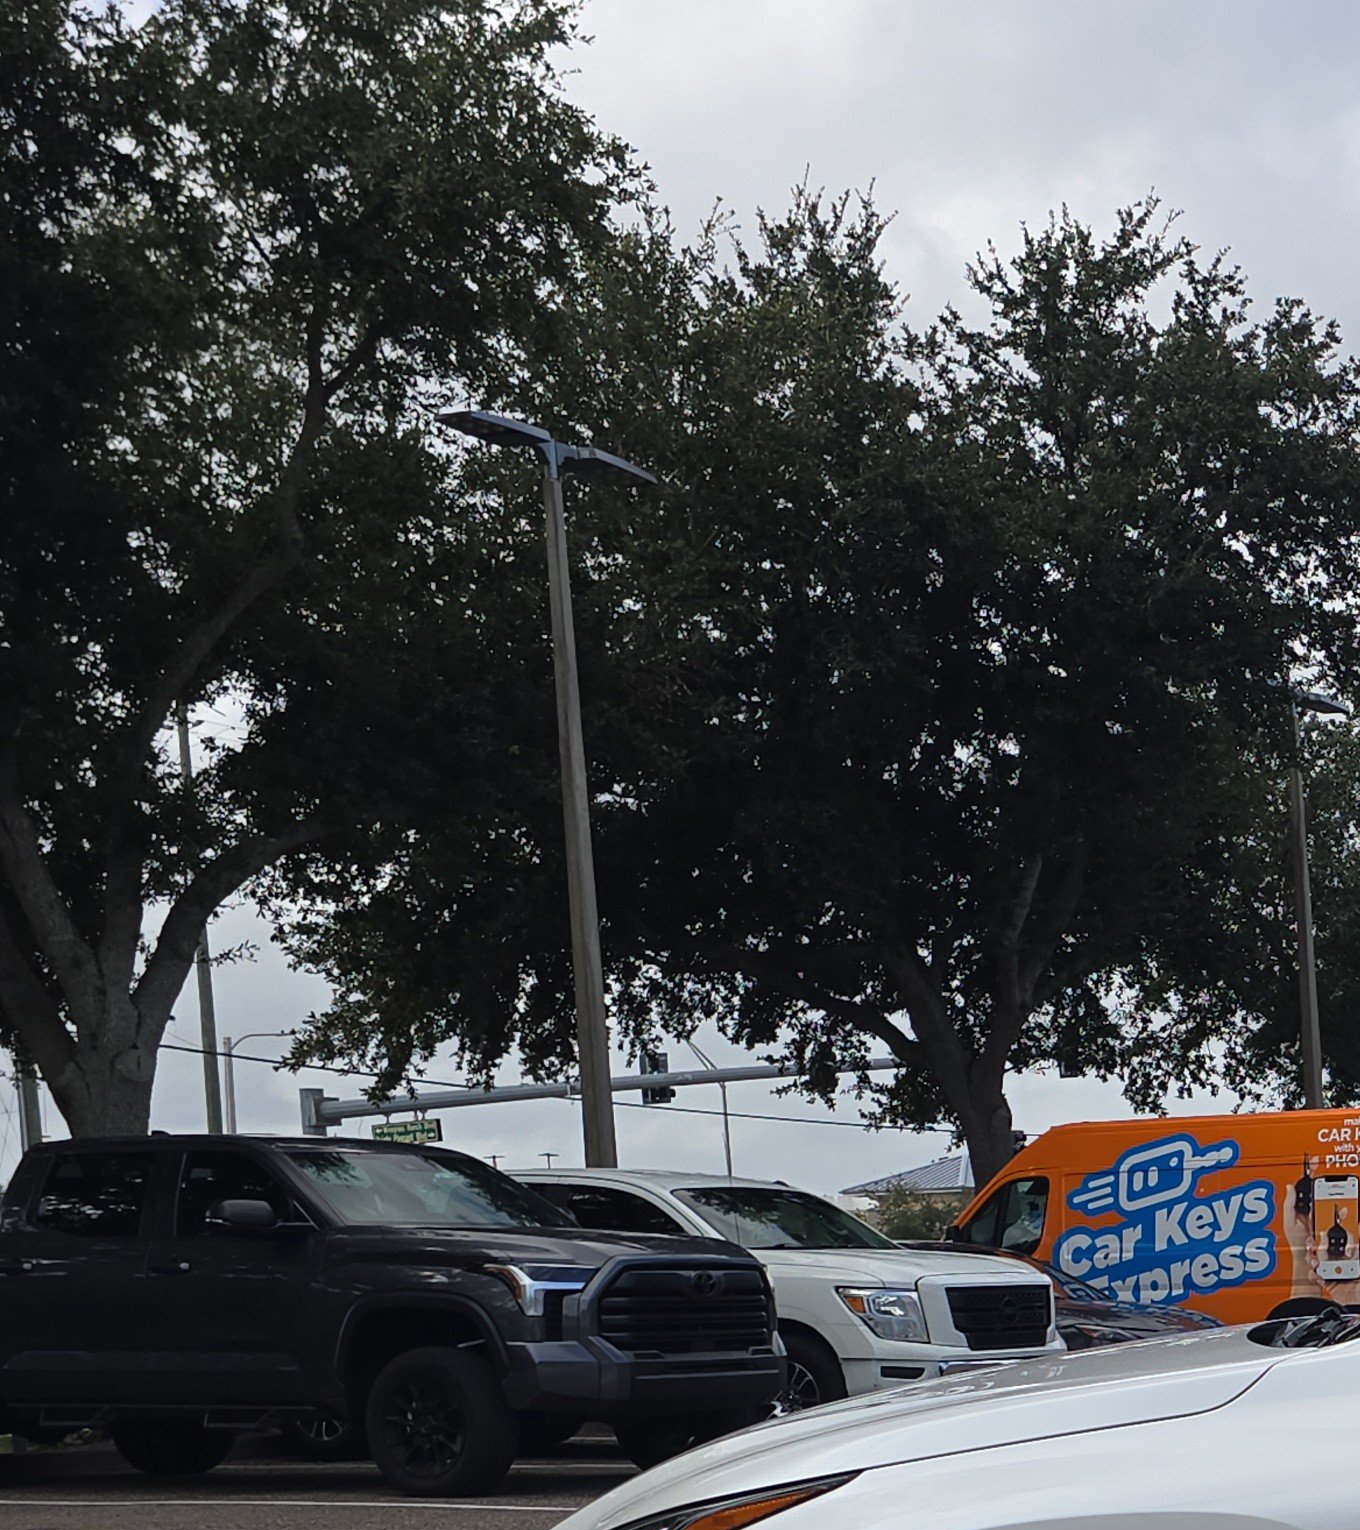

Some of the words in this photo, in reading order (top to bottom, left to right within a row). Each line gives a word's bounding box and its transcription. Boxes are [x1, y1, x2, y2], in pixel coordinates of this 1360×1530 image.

[1317, 1127, 1352, 1143] CAR
[1334, 1143, 1355, 1152] with
[1059, 1223, 1143, 1277] Car
[1154, 1187, 1269, 1252] Keys
